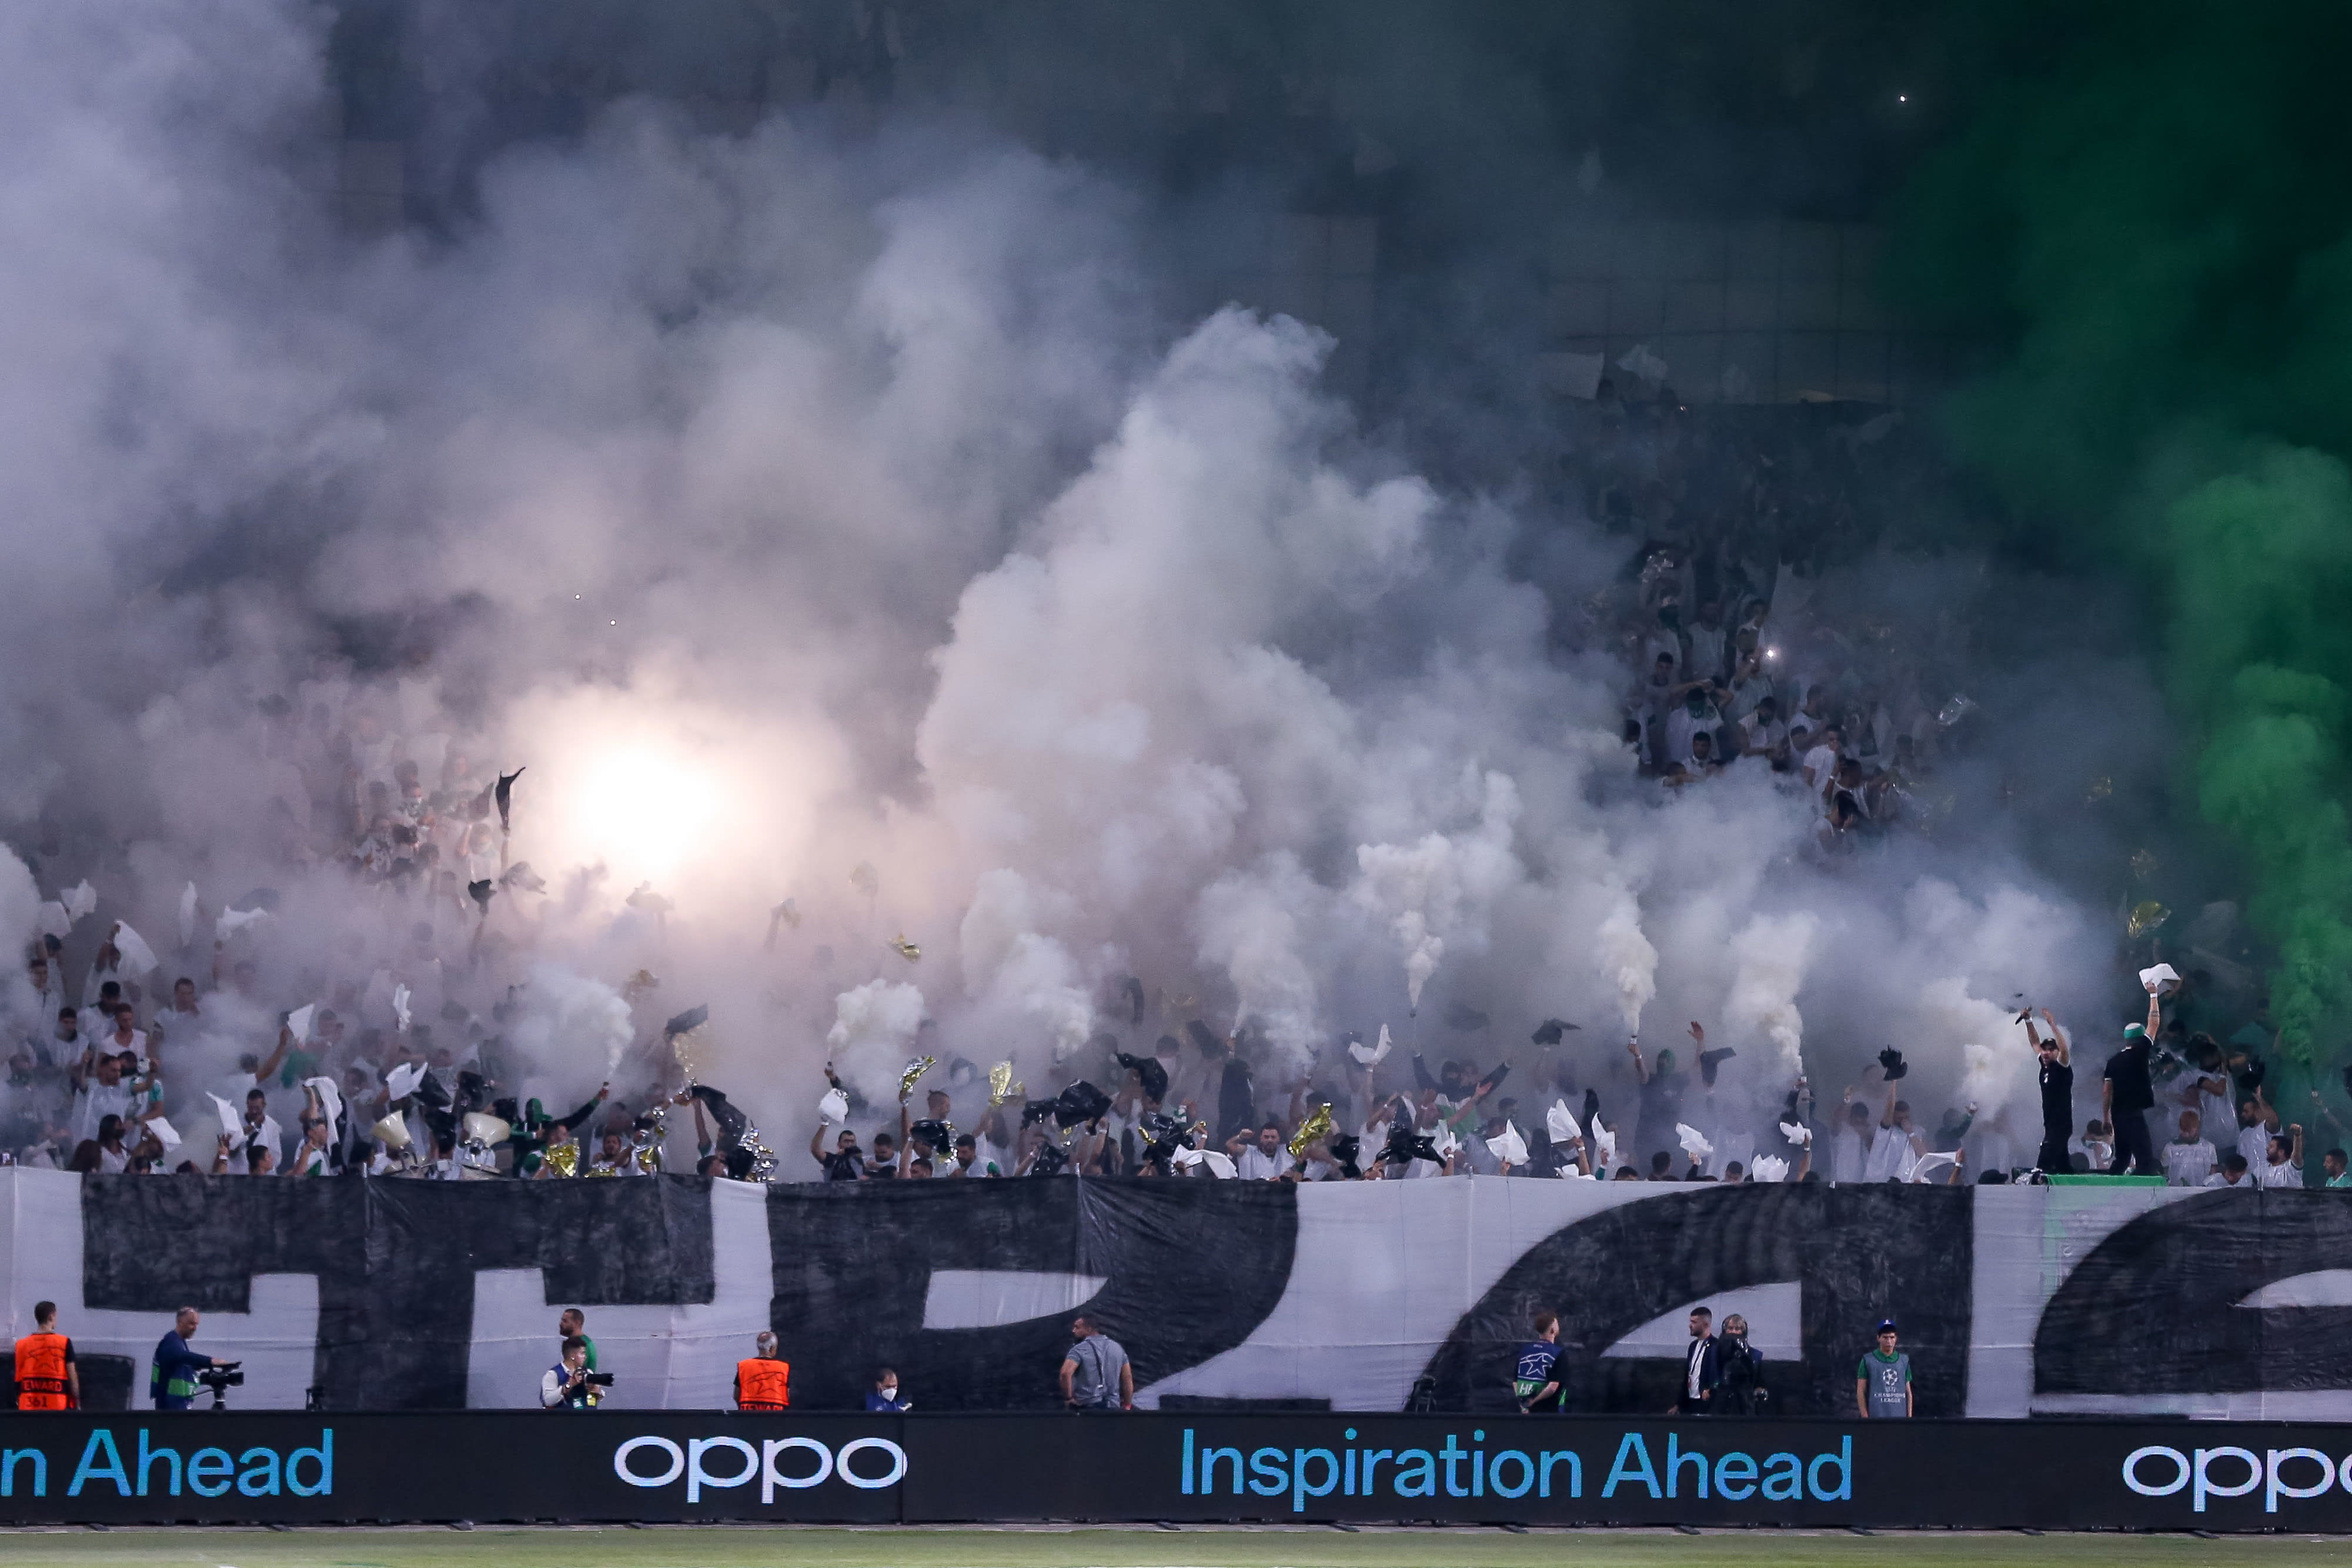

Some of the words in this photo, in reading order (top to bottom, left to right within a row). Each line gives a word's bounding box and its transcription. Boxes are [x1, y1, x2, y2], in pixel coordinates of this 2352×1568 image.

[23, 1379, 62, 1392] EWARD
[67, 1429, 333, 1497] Ahead
[614, 1435, 908, 1504] oppo
[1181, 1427, 1582, 1512] Inspiration
[1601, 1432, 1852, 1502] Ahead
[2122, 1445, 2352, 1513] opp
